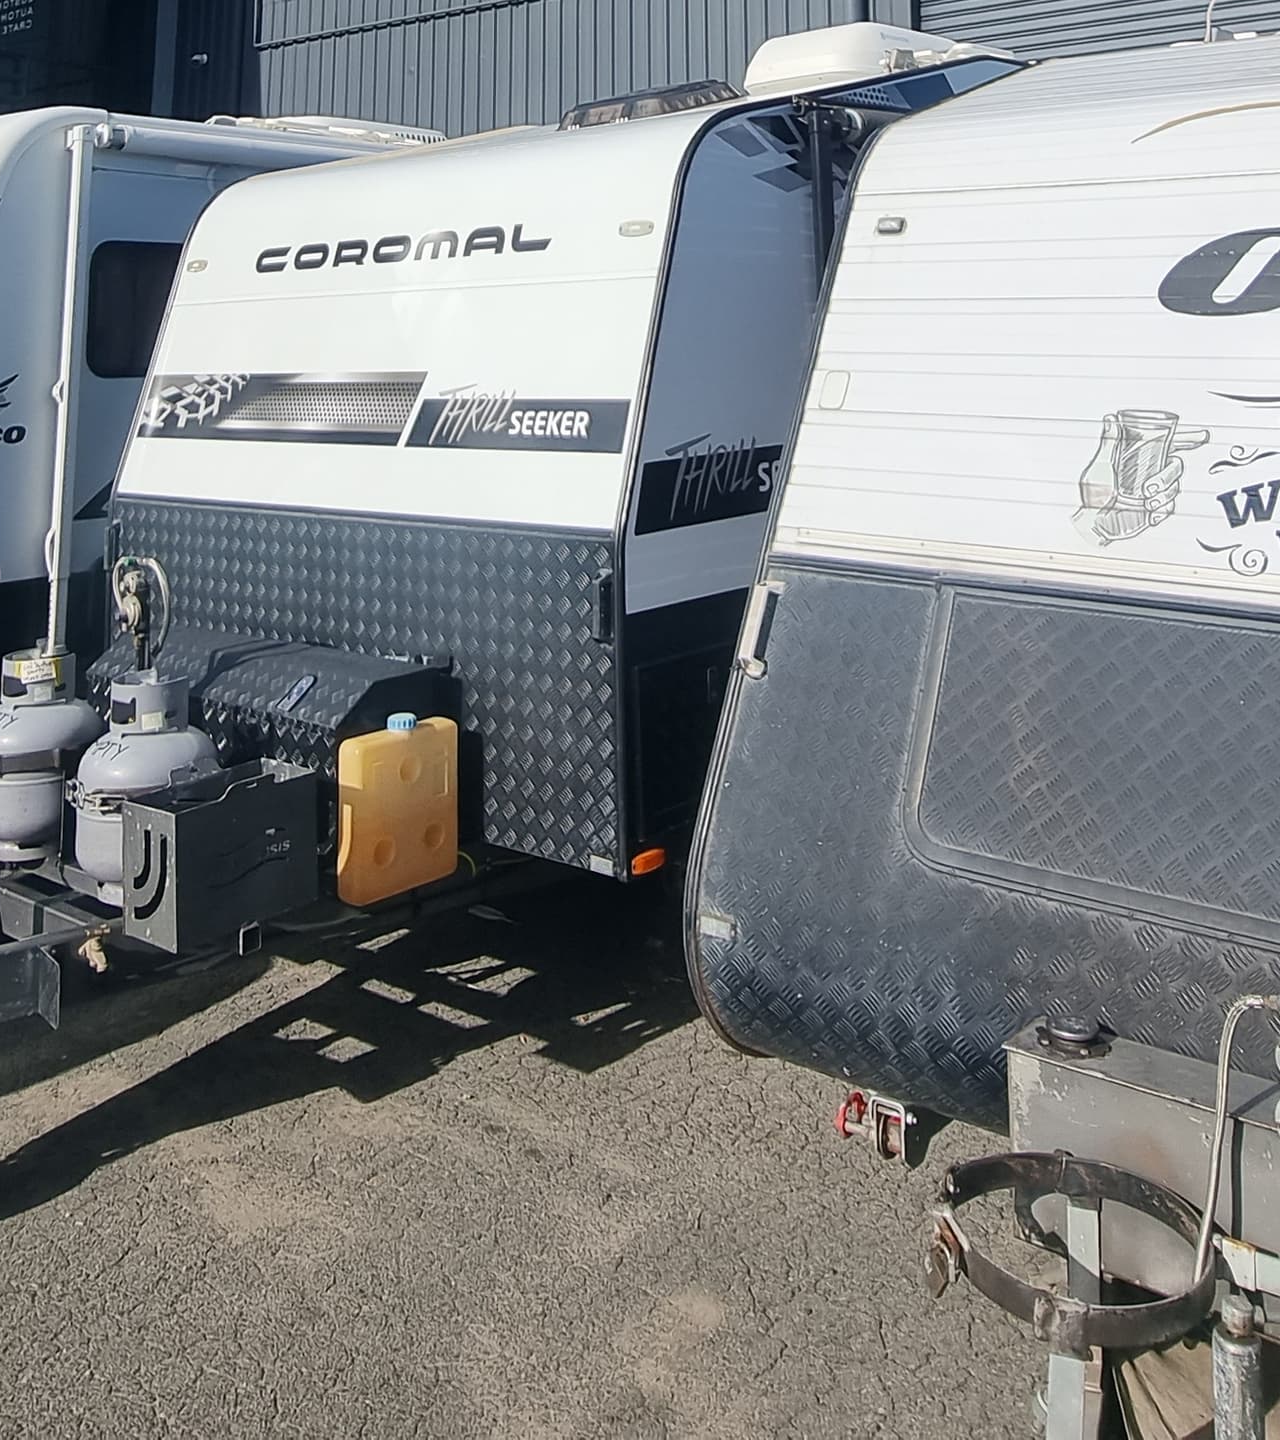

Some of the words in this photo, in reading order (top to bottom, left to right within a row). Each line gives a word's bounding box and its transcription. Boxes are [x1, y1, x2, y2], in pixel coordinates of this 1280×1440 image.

[256, 224, 552, 273] COROMAL
[428, 383, 517, 445] THRILL
[508, 410, 590, 439] SEEKER
[665, 433, 757, 521] THRILL
